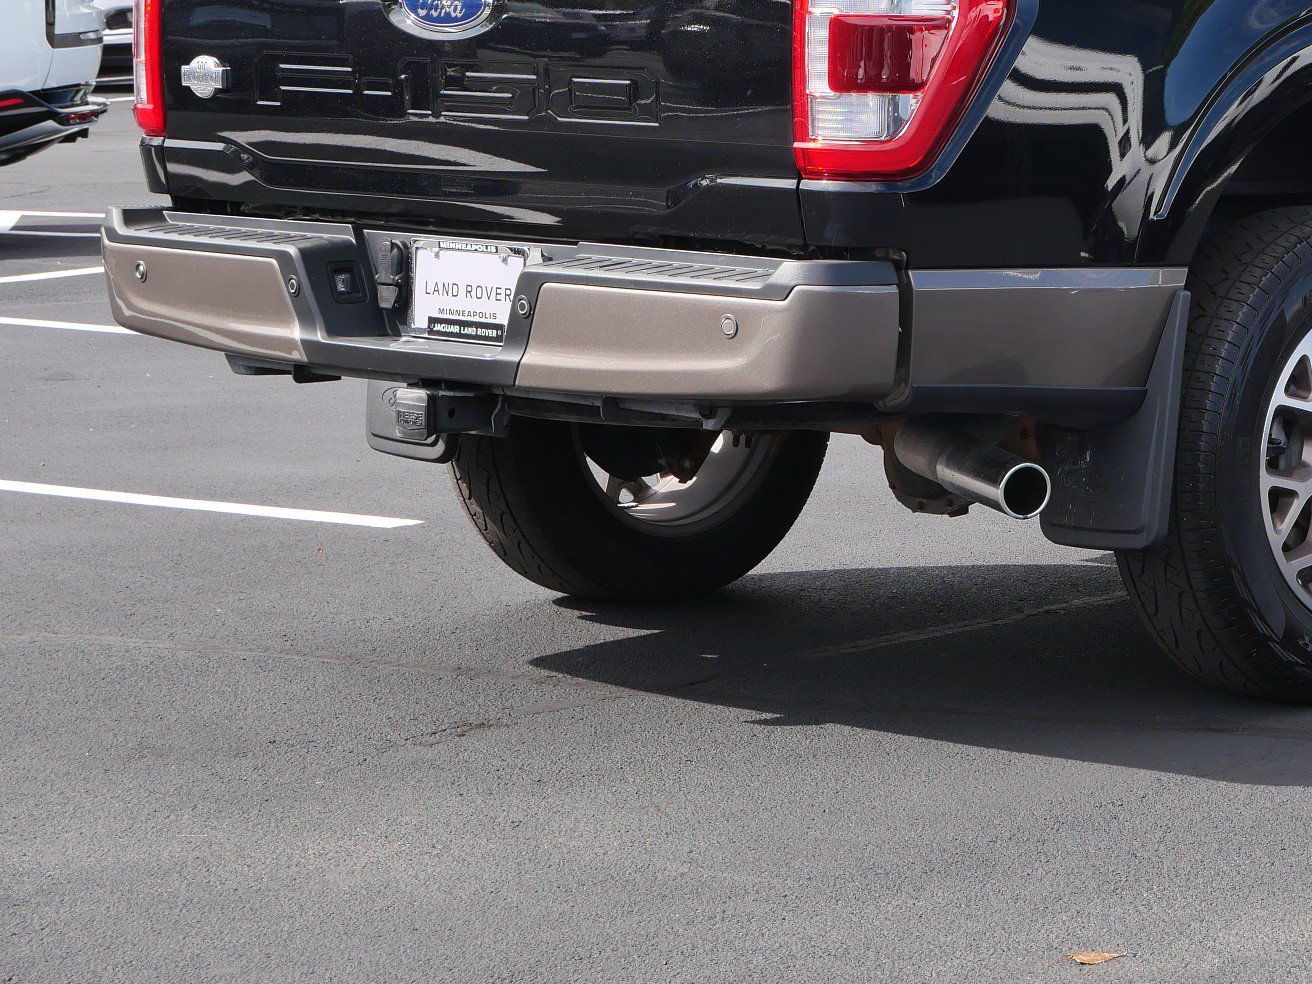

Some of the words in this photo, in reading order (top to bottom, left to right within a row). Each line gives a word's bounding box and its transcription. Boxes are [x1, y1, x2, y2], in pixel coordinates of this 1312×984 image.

[256, 52, 660, 126] F-150
[439, 241, 497, 253] MINNEAPOLIS
[424, 280, 459, 298] LAND
[465, 284, 512, 303] ROVER
[438, 307, 498, 320] MINNEAPOLIS
[432, 323, 460, 334] JAGUAR
[460, 325, 476, 335] LAND
[477, 327, 497, 338] ROVER
